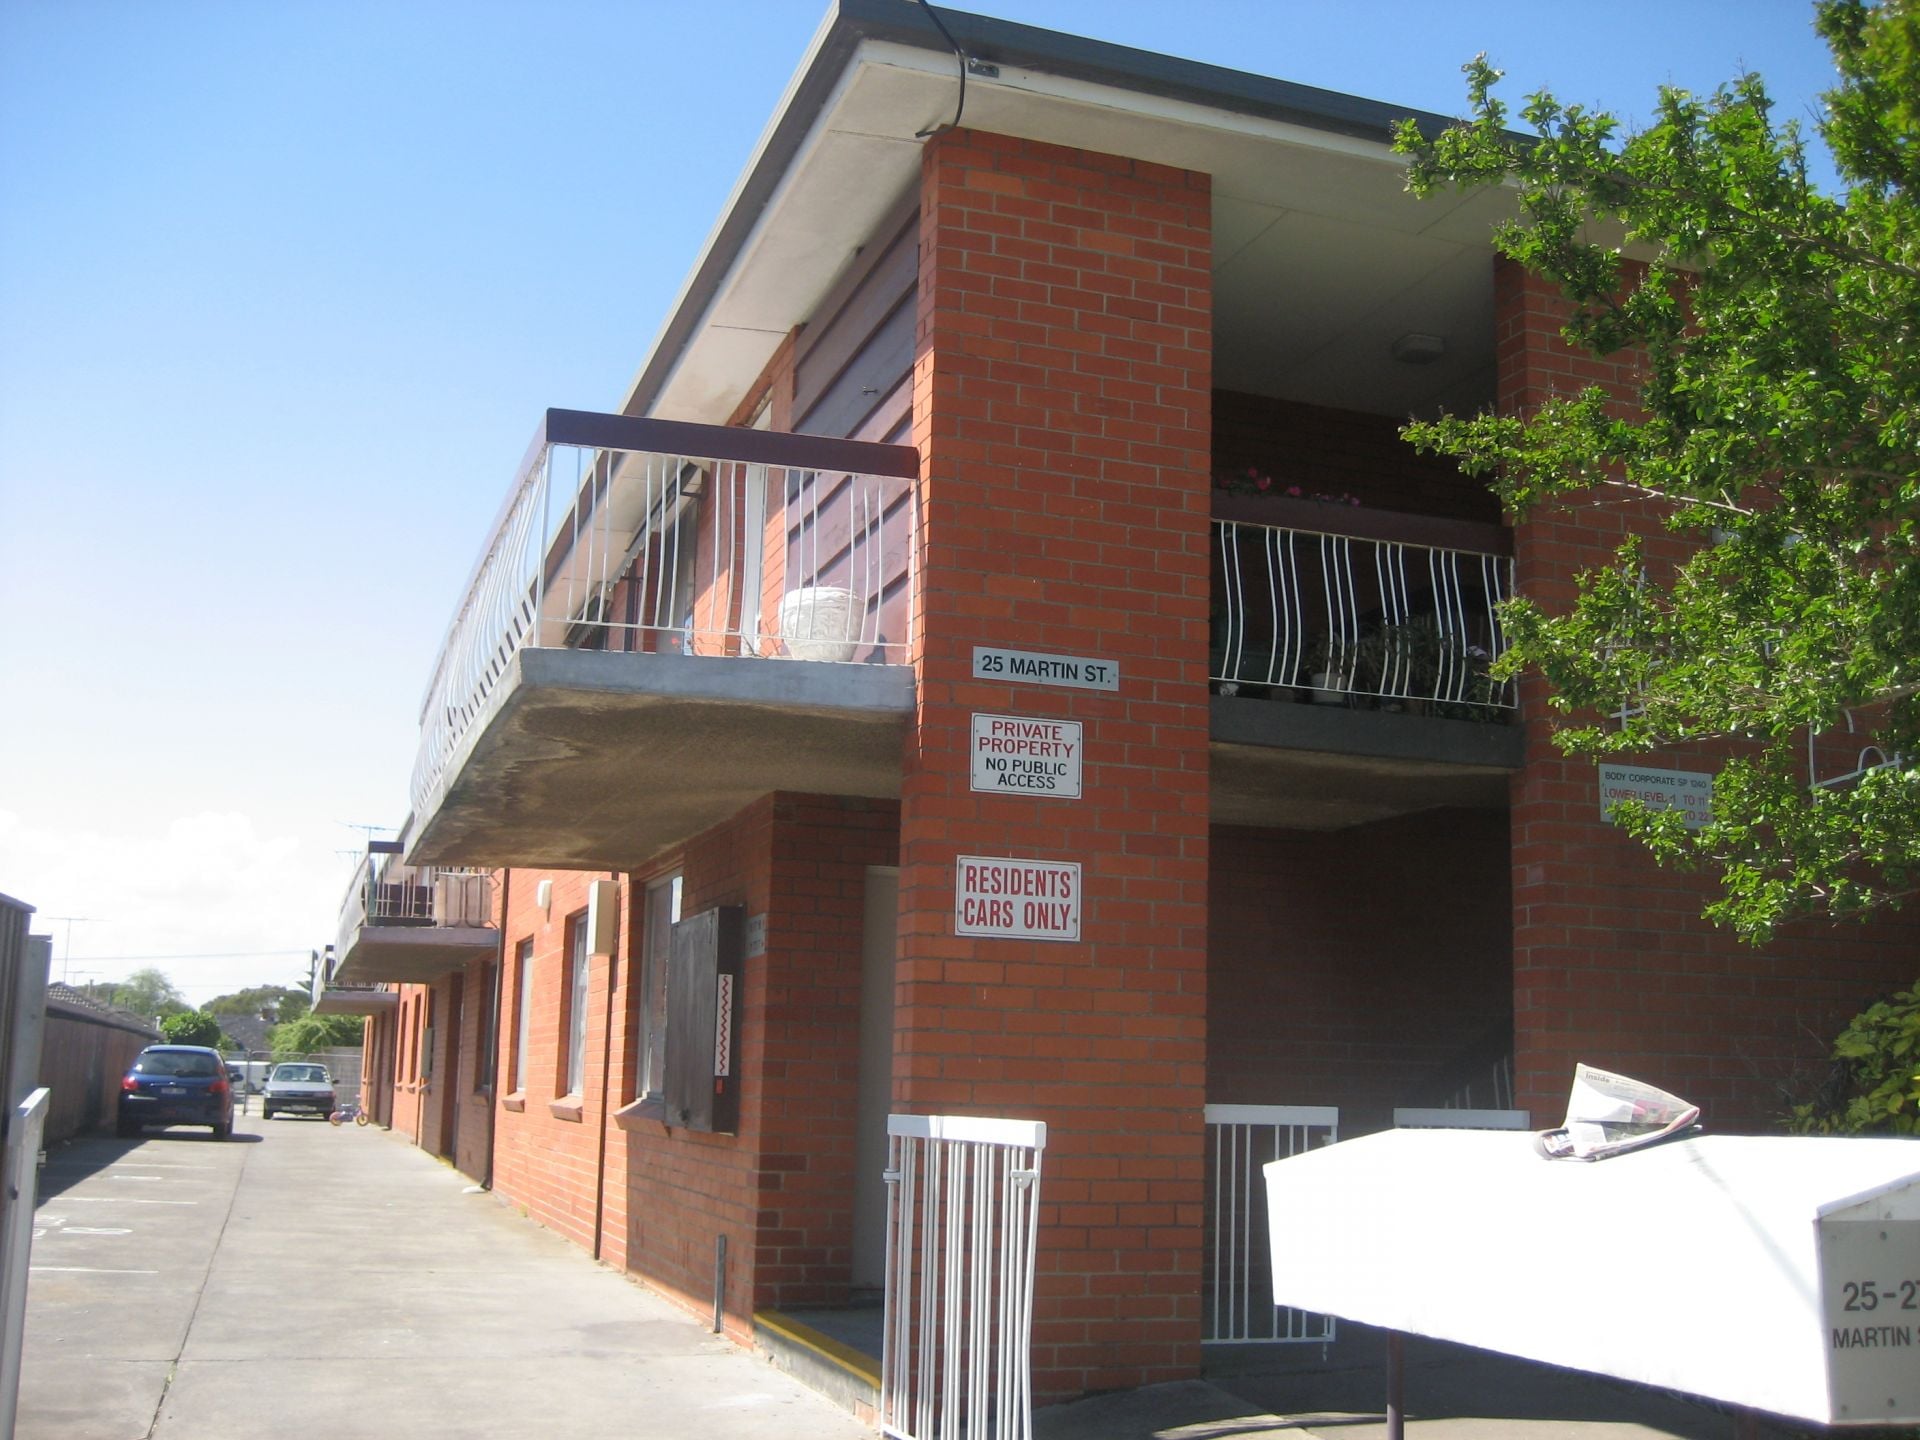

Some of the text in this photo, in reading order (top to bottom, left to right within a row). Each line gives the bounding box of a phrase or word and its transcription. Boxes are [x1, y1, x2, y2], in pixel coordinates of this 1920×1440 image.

[982, 655, 1111, 684] 25 MARTIN ST.
[991, 721, 1063, 741] PRIVATE
[978, 737, 1075, 759] PROPERTY
[985, 757, 1068, 777] NO PUBLIC
[997, 774, 1056, 790] ACCESS
[1605, 771, 1627, 781] BODY
[1629, 773, 1676, 786] CORPORATE
[1604, 786, 1637, 799] LOWER
[1683, 794, 1696, 806] TO
[965, 865, 1072, 899] RESIDENTS
[963, 898, 1072, 931] CARS ONLY
[1832, 1326, 1911, 1349] MARTIN
